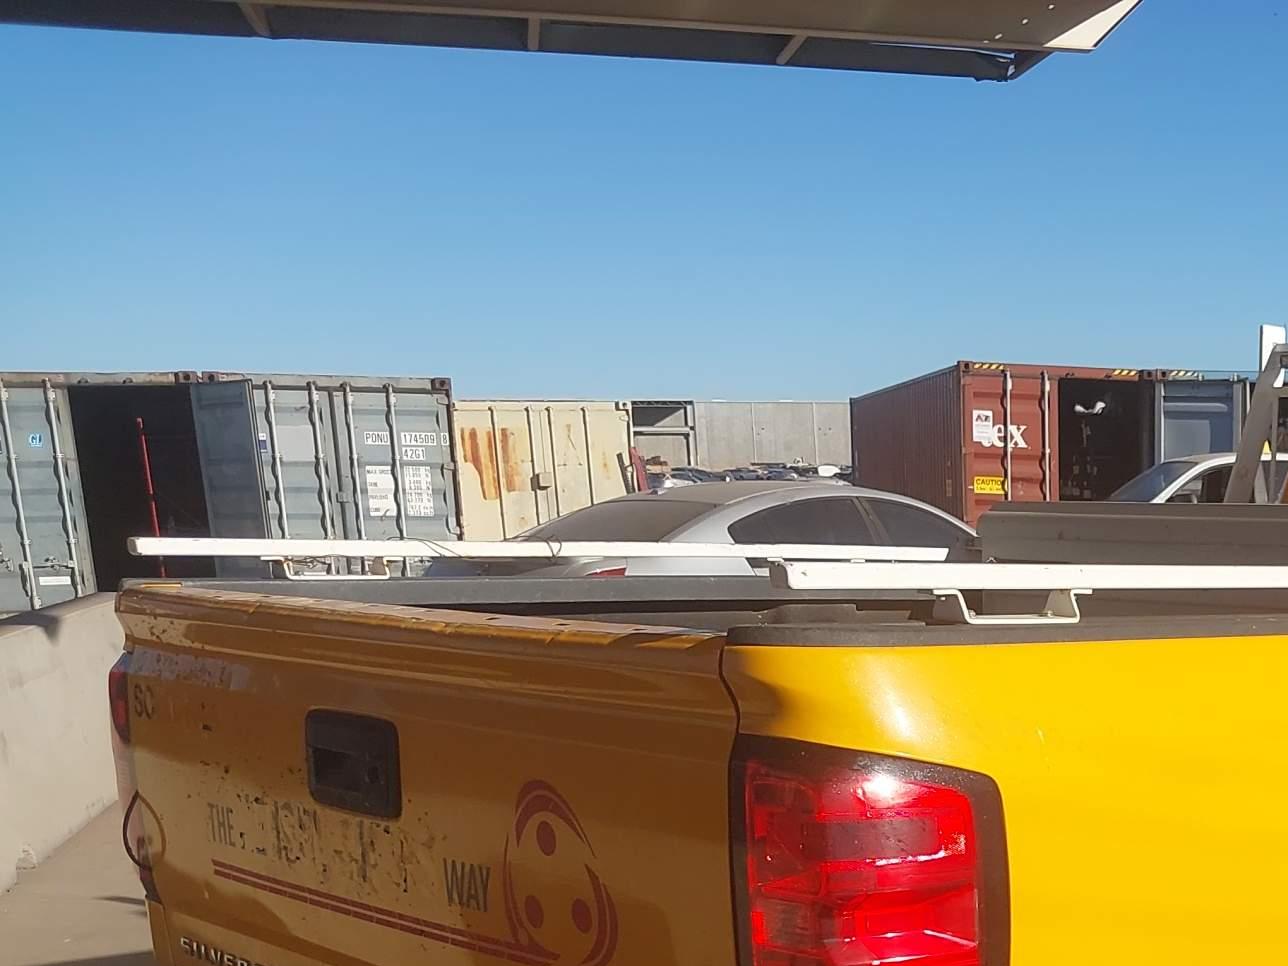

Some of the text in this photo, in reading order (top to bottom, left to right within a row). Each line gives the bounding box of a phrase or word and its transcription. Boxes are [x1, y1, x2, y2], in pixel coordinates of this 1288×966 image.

[365, 432, 389, 444] PONU
[403, 433, 436, 444] 174509
[404, 448, 425, 460] 42G1
[975, 478, 1004, 486] CAUTIO
[443, 857, 491, 912] WAY
